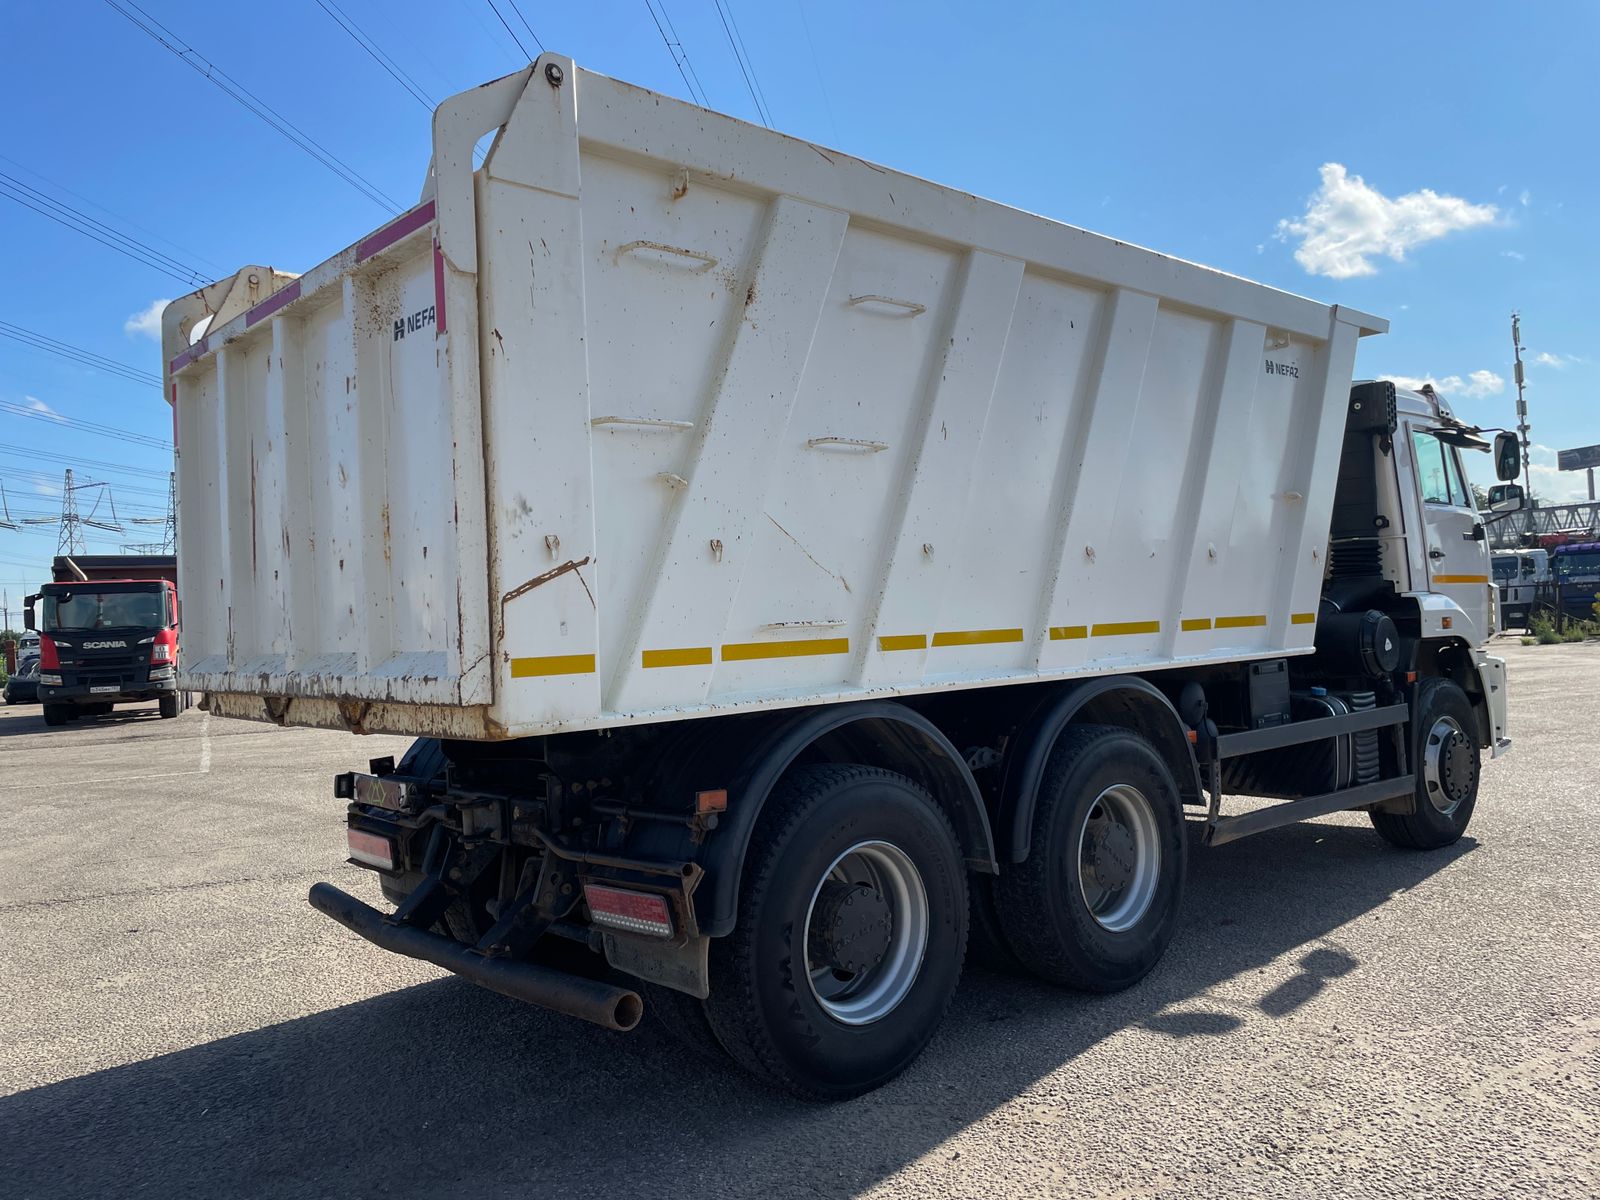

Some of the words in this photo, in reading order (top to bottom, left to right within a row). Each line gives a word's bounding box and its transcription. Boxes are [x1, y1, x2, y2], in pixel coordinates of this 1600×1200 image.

[407, 305, 436, 334] NEFA
[1275, 363, 1299, 379] NEFAZ
[82, 641, 128, 650] SCANIA
